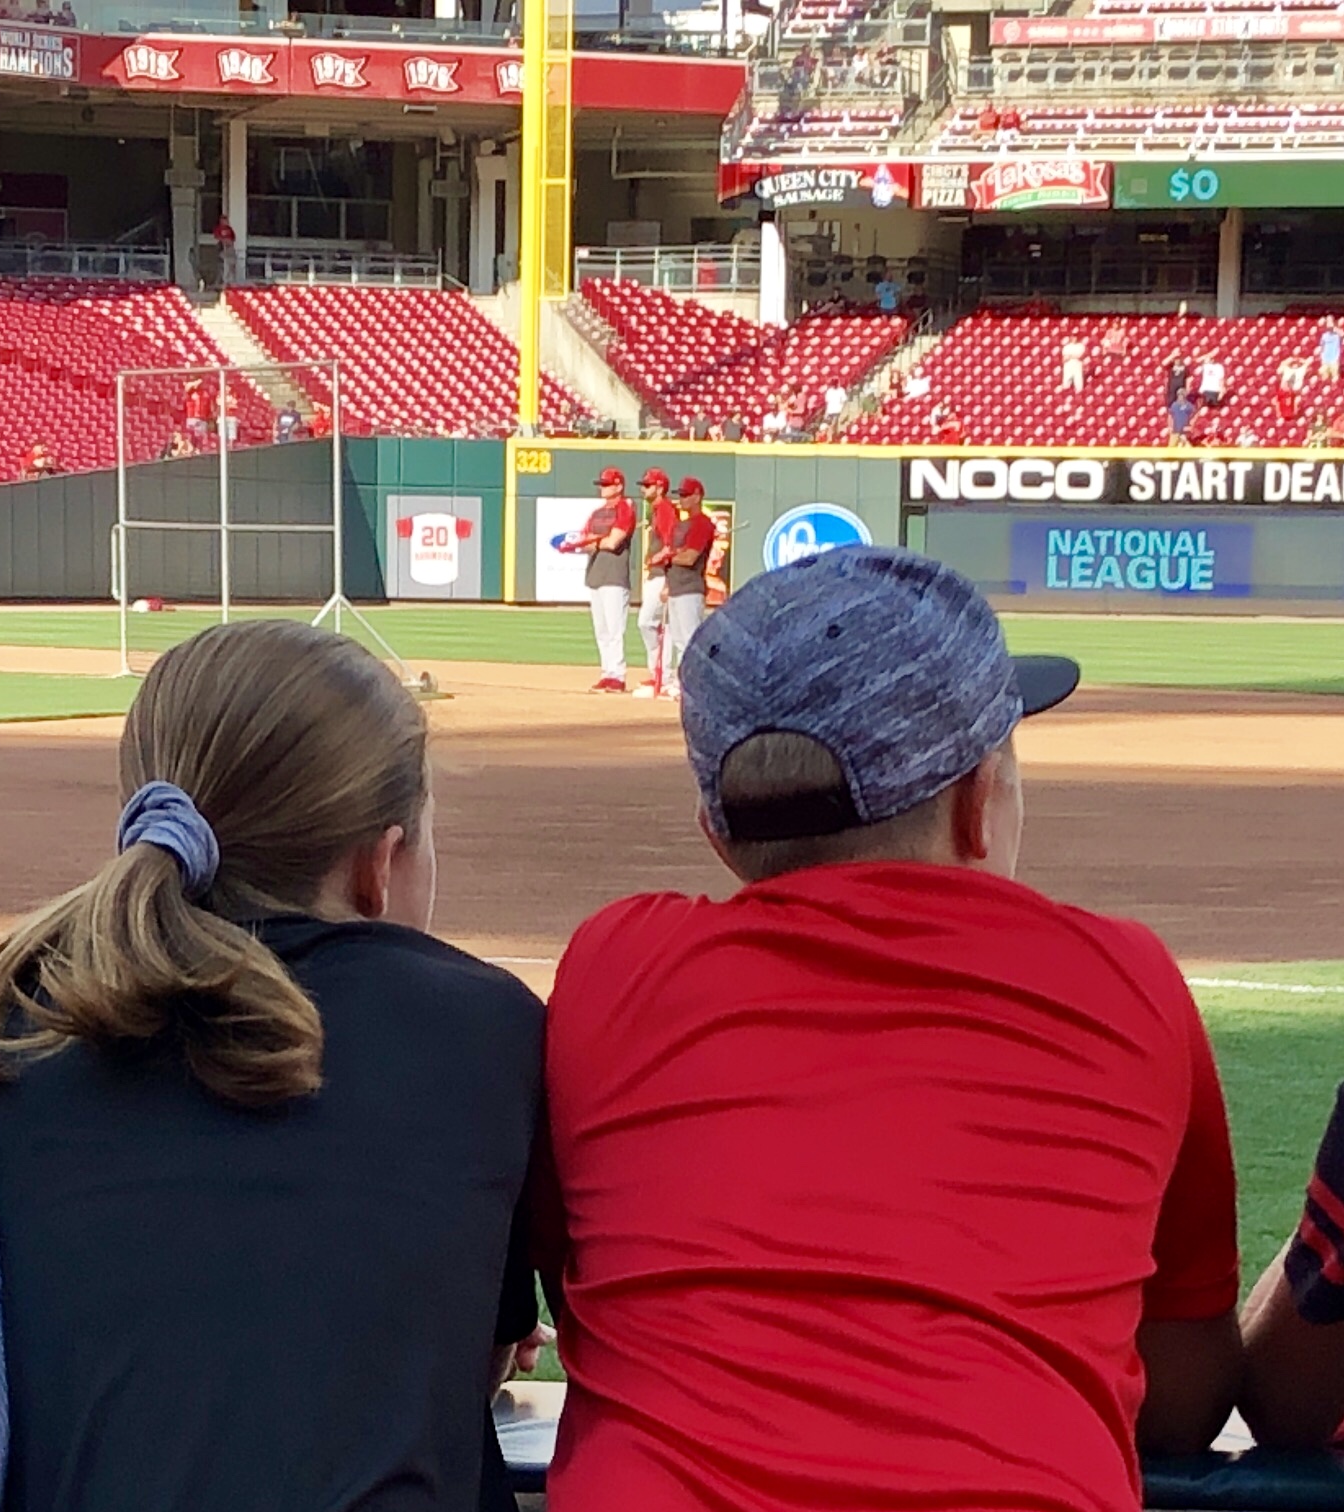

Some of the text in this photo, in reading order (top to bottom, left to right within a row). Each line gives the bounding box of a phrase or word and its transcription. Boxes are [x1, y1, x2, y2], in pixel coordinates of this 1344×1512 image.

[127, 46, 170, 78] 1919
[314, 53, 357, 84] 1975
[755, 168, 864, 199] QUEEN CITY
[921, 188, 966, 207] PIZZA
[1169, 168, 1219, 202] $0
[515, 450, 552, 474] 328
[908, 458, 1106, 501] NOCO
[1128, 459, 1254, 502] START
[422, 525, 449, 547] 20
[1046, 529, 1215, 557] NATIONAL
[1045, 556, 1215, 592] LEAGUE
